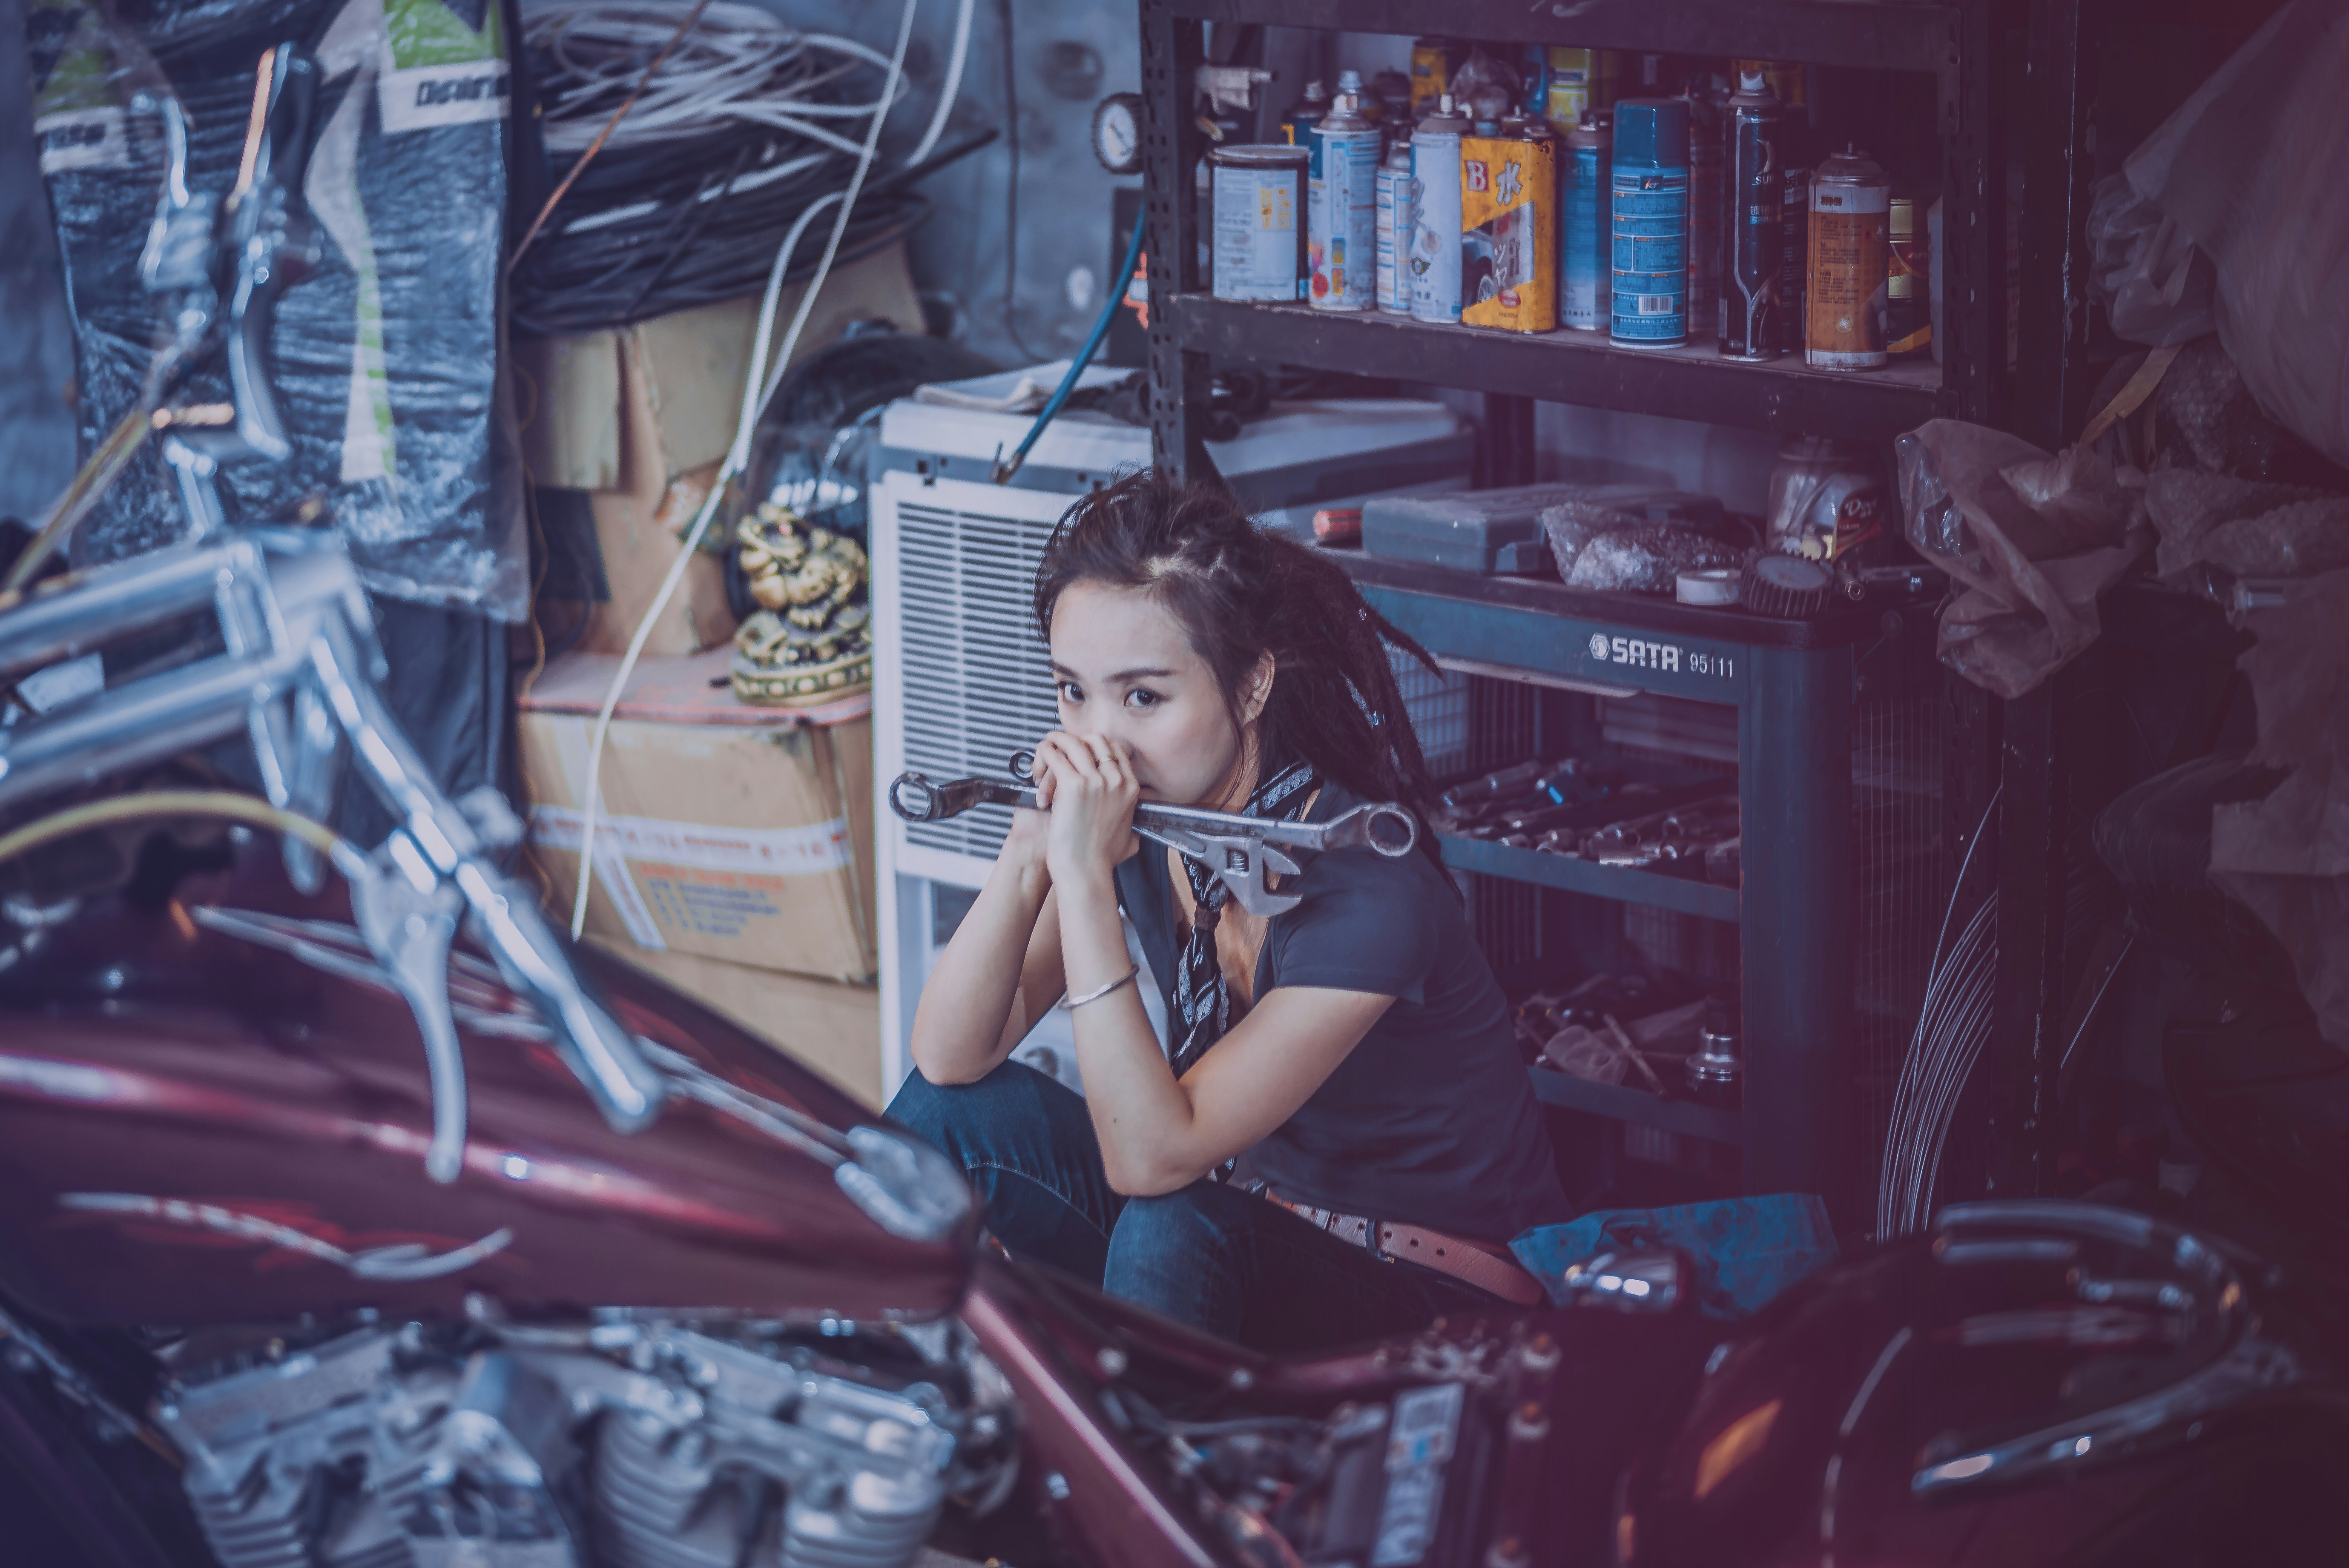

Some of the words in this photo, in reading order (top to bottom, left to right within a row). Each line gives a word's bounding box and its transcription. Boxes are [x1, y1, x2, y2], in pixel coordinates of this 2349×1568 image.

[1496, 160, 1523, 206] 水
[1612, 636, 1679, 672] SATA
[1690, 651, 1733, 678] 95111
